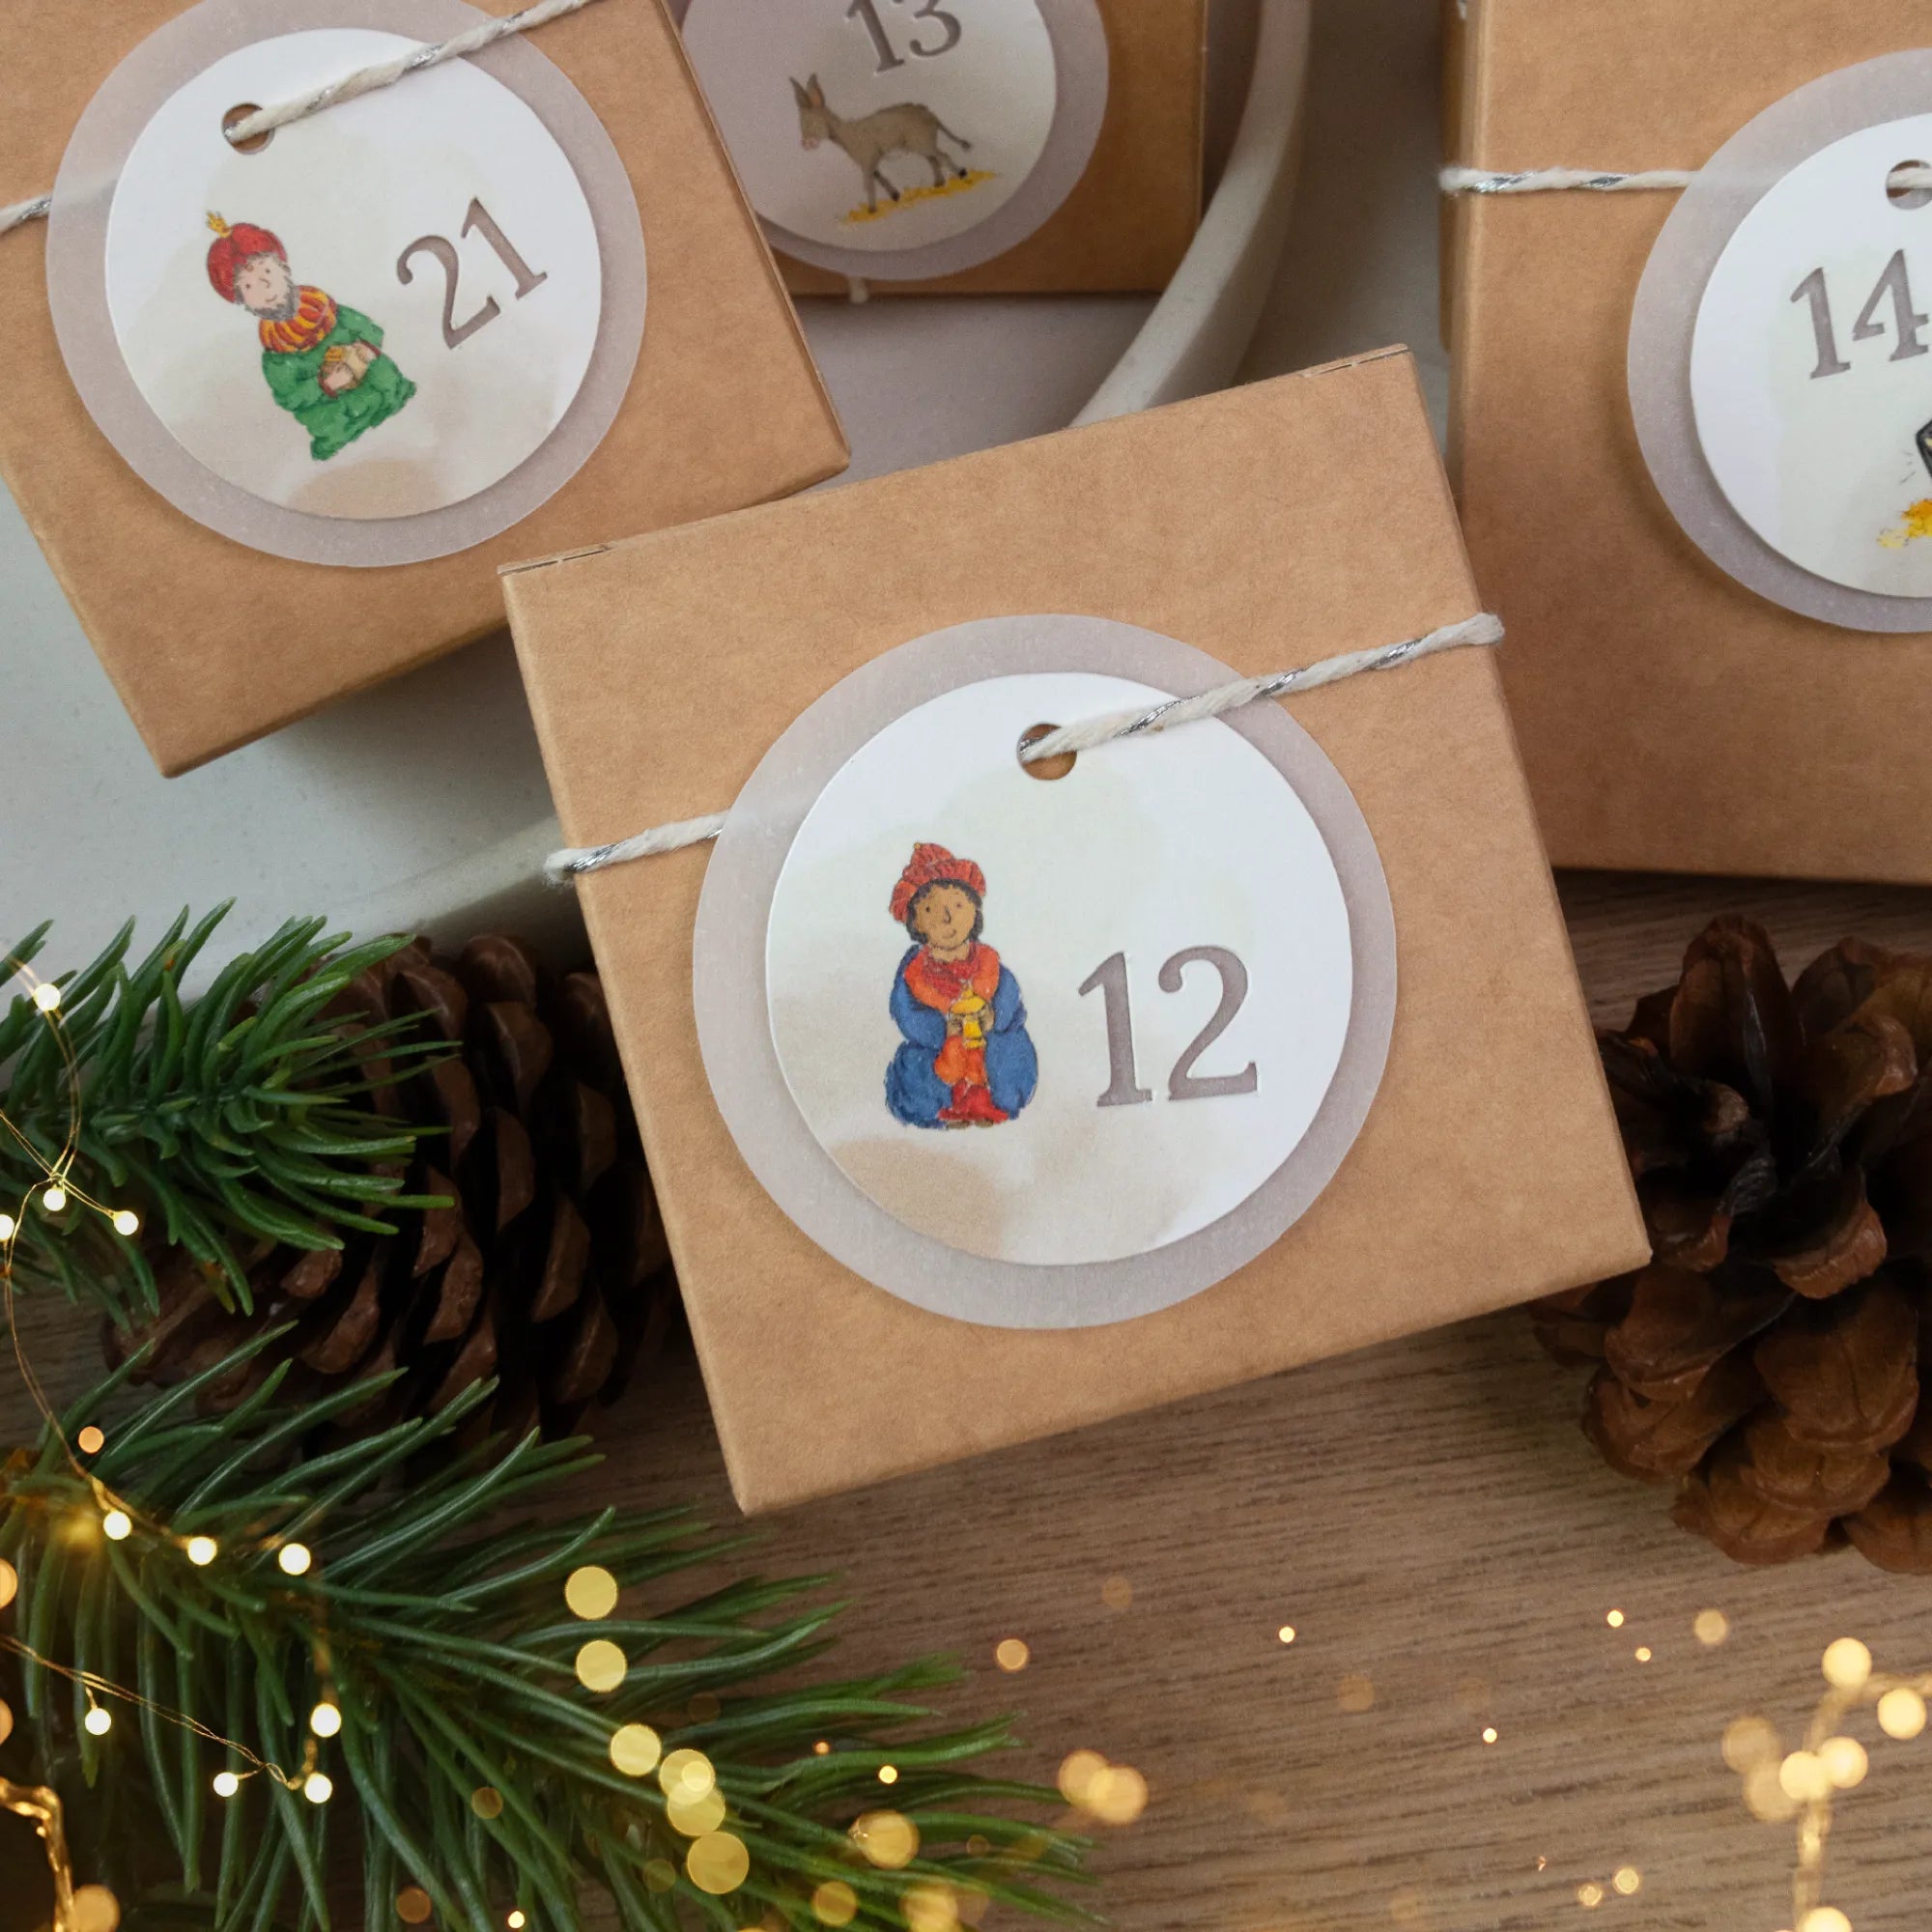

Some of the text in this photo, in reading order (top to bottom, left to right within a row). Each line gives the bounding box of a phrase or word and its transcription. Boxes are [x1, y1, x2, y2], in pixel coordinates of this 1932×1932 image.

[846, 0, 962, 72] 13
[397, 197, 548, 349] 21
[1790, 248, 1929, 378] 14
[1078, 946, 1258, 1106] 12
